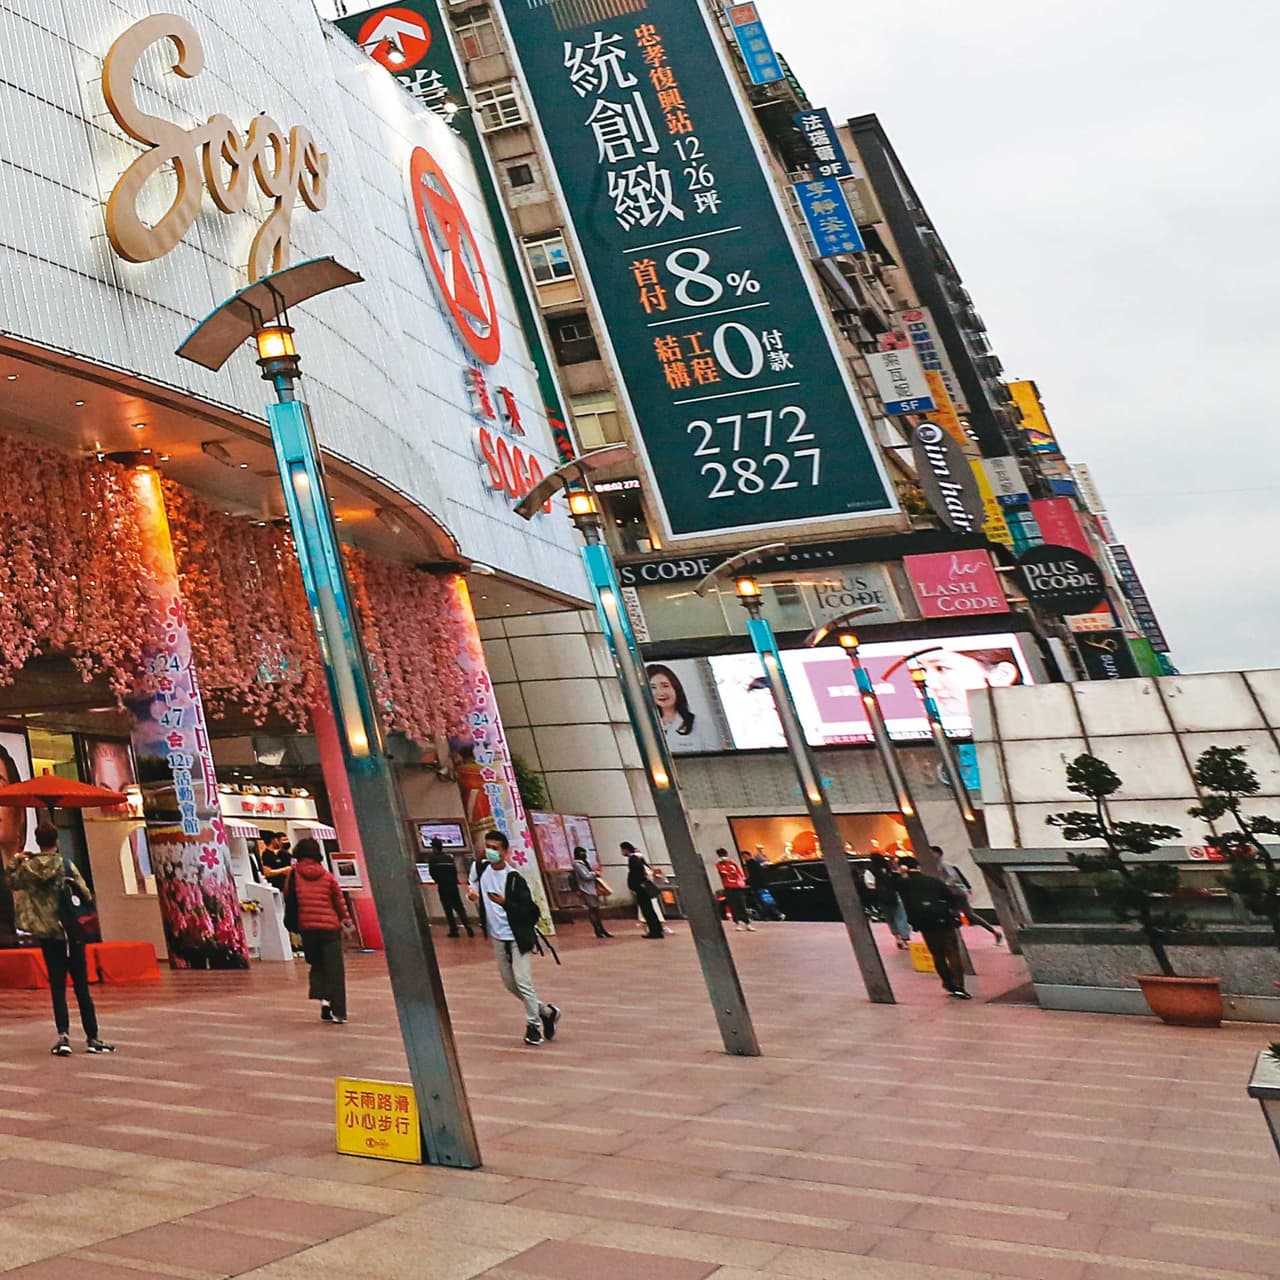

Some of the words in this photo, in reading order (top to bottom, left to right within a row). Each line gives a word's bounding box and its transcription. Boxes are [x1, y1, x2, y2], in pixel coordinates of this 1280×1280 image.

[634, 24, 694, 135] 忠孝復興站
[563, 31, 686, 232] 統創緻
[102, 13, 329, 286] Sogo
[819, 162, 843, 177] 9F
[629, 258, 668, 314] 首付
[666, 248, 760, 307] 8%
[654, 334, 692, 390] 結構
[682, 331, 721, 386] 工程
[713, 322, 765, 380] 0
[762, 329, 794, 372] 付款
[900, 400, 920, 411] 5F
[687, 406, 815, 457] 2772
[701, 448, 821, 500] 2827
[939, 481, 975, 532] hair
[917, 581, 978, 598] LASH
[1022, 560, 1080, 592] PLUS
[1037, 573, 1100, 592] CODE
[814, 576, 868, 609] PLUS
[825, 590, 886, 608] CODE
[936, 596, 1002, 612] CODE
[149, 654, 180, 673] 324
[160, 708, 183, 727] 47
[176, 772, 199, 834] 活動會館
[344, 1089, 409, 1114] 天雨路滑
[345, 1110, 410, 1135] 小心步行
